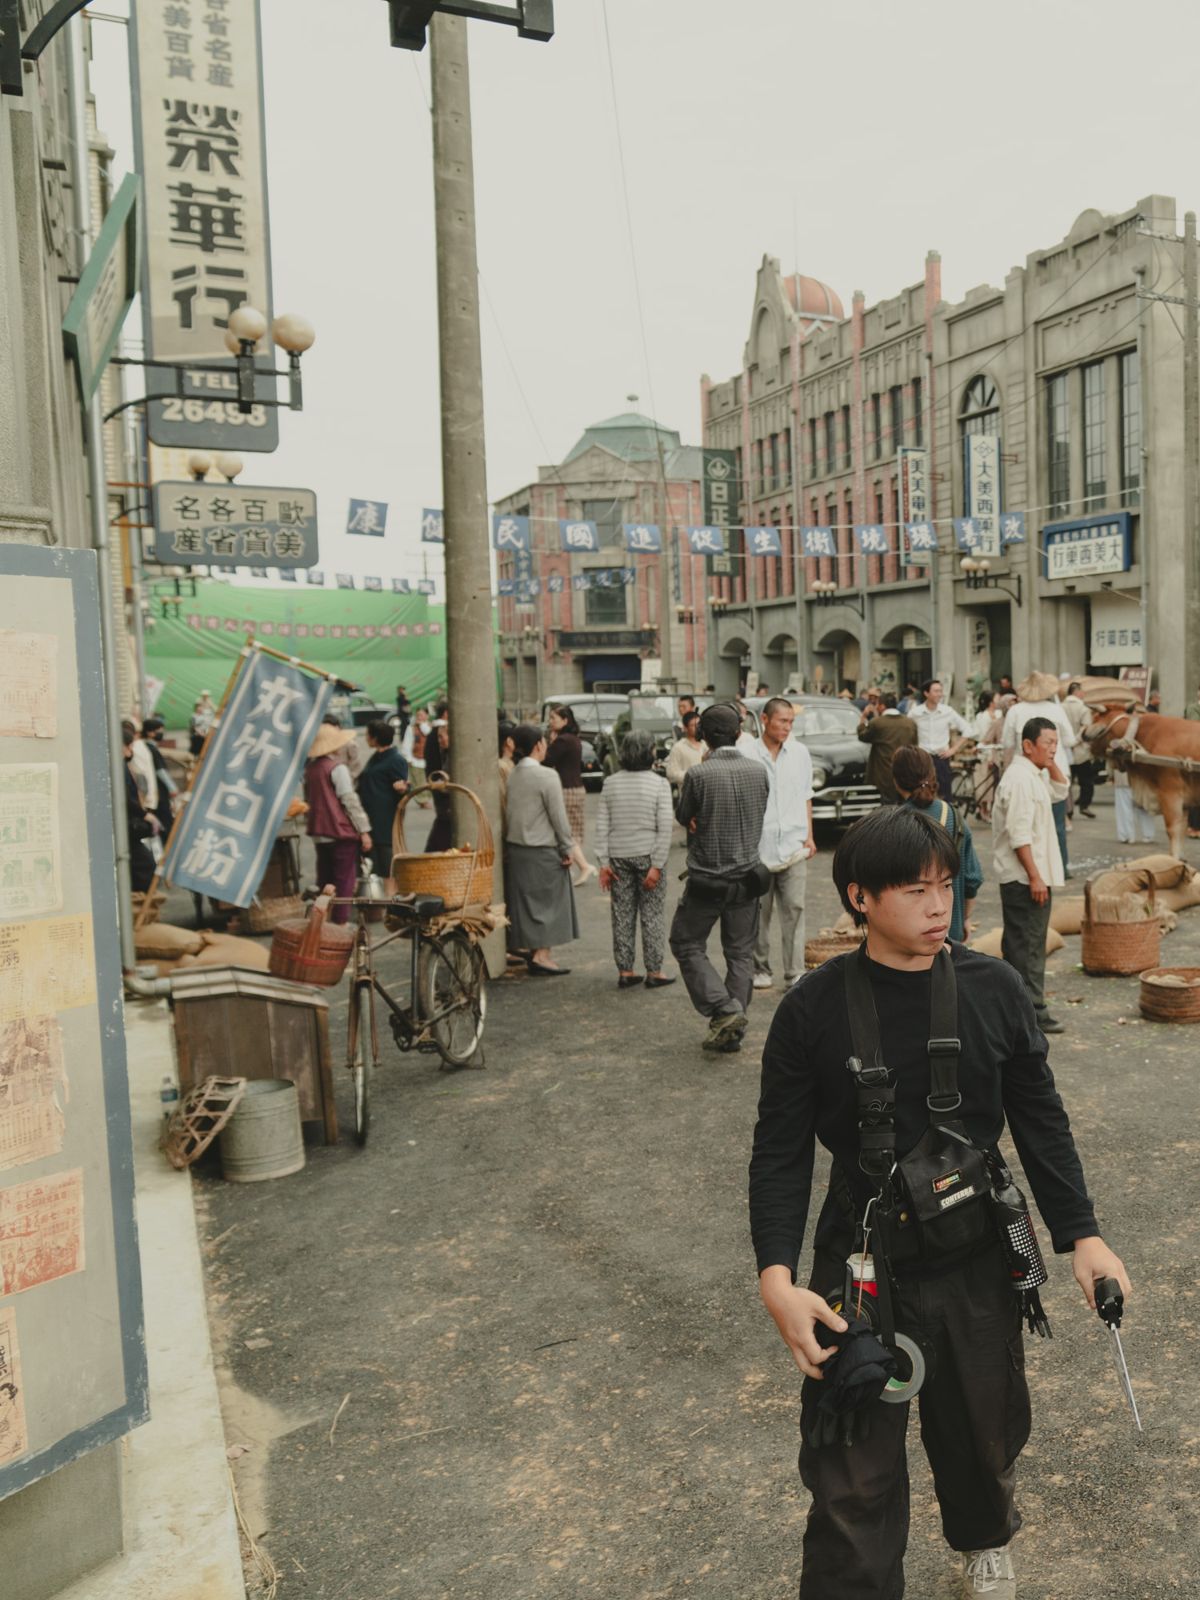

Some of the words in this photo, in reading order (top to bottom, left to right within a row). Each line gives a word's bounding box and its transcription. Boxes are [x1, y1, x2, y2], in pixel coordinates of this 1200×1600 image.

[162, 0, 195, 82] 美百貨
[163, 98, 248, 329] 榮華行
[186, 371, 239, 390] TEL
